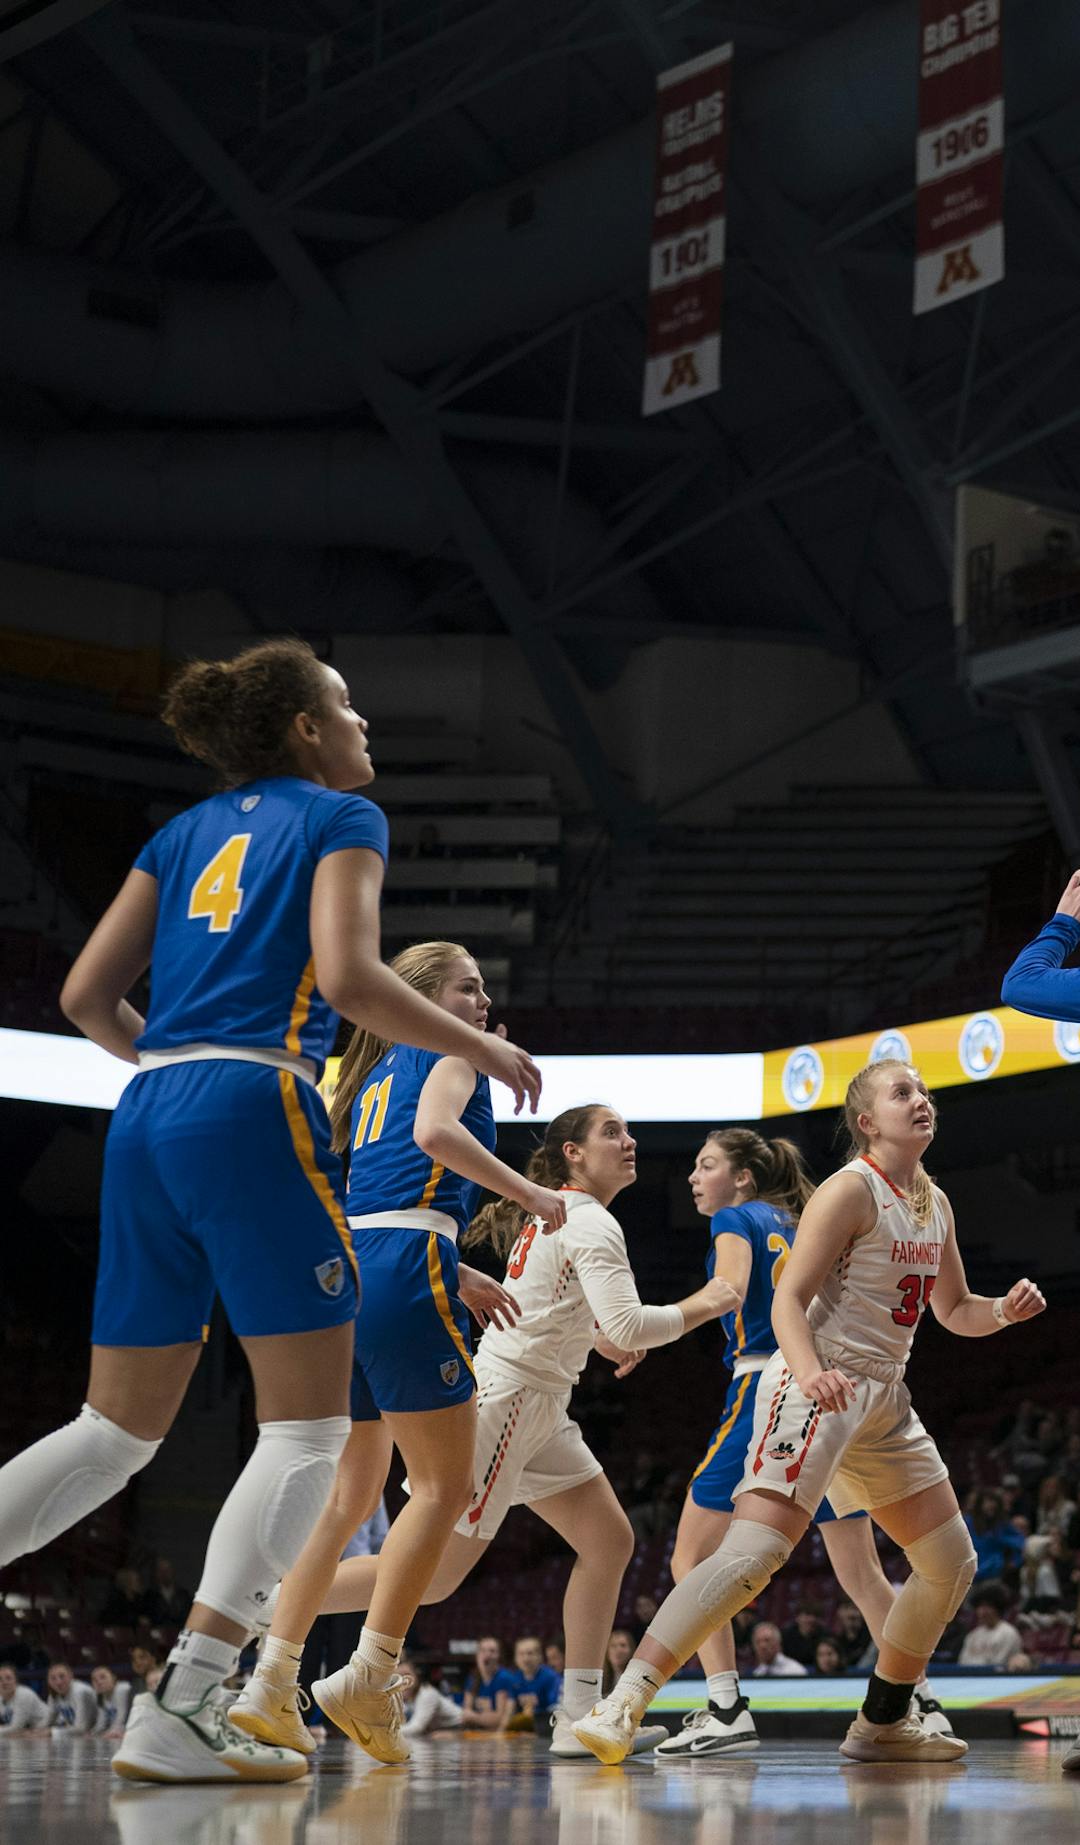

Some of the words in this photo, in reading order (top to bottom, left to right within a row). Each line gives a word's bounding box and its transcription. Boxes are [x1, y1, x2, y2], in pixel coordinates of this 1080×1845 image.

[932, 115, 988, 168] 1906
[187, 833, 253, 933] 4
[353, 1073, 395, 1152] 11
